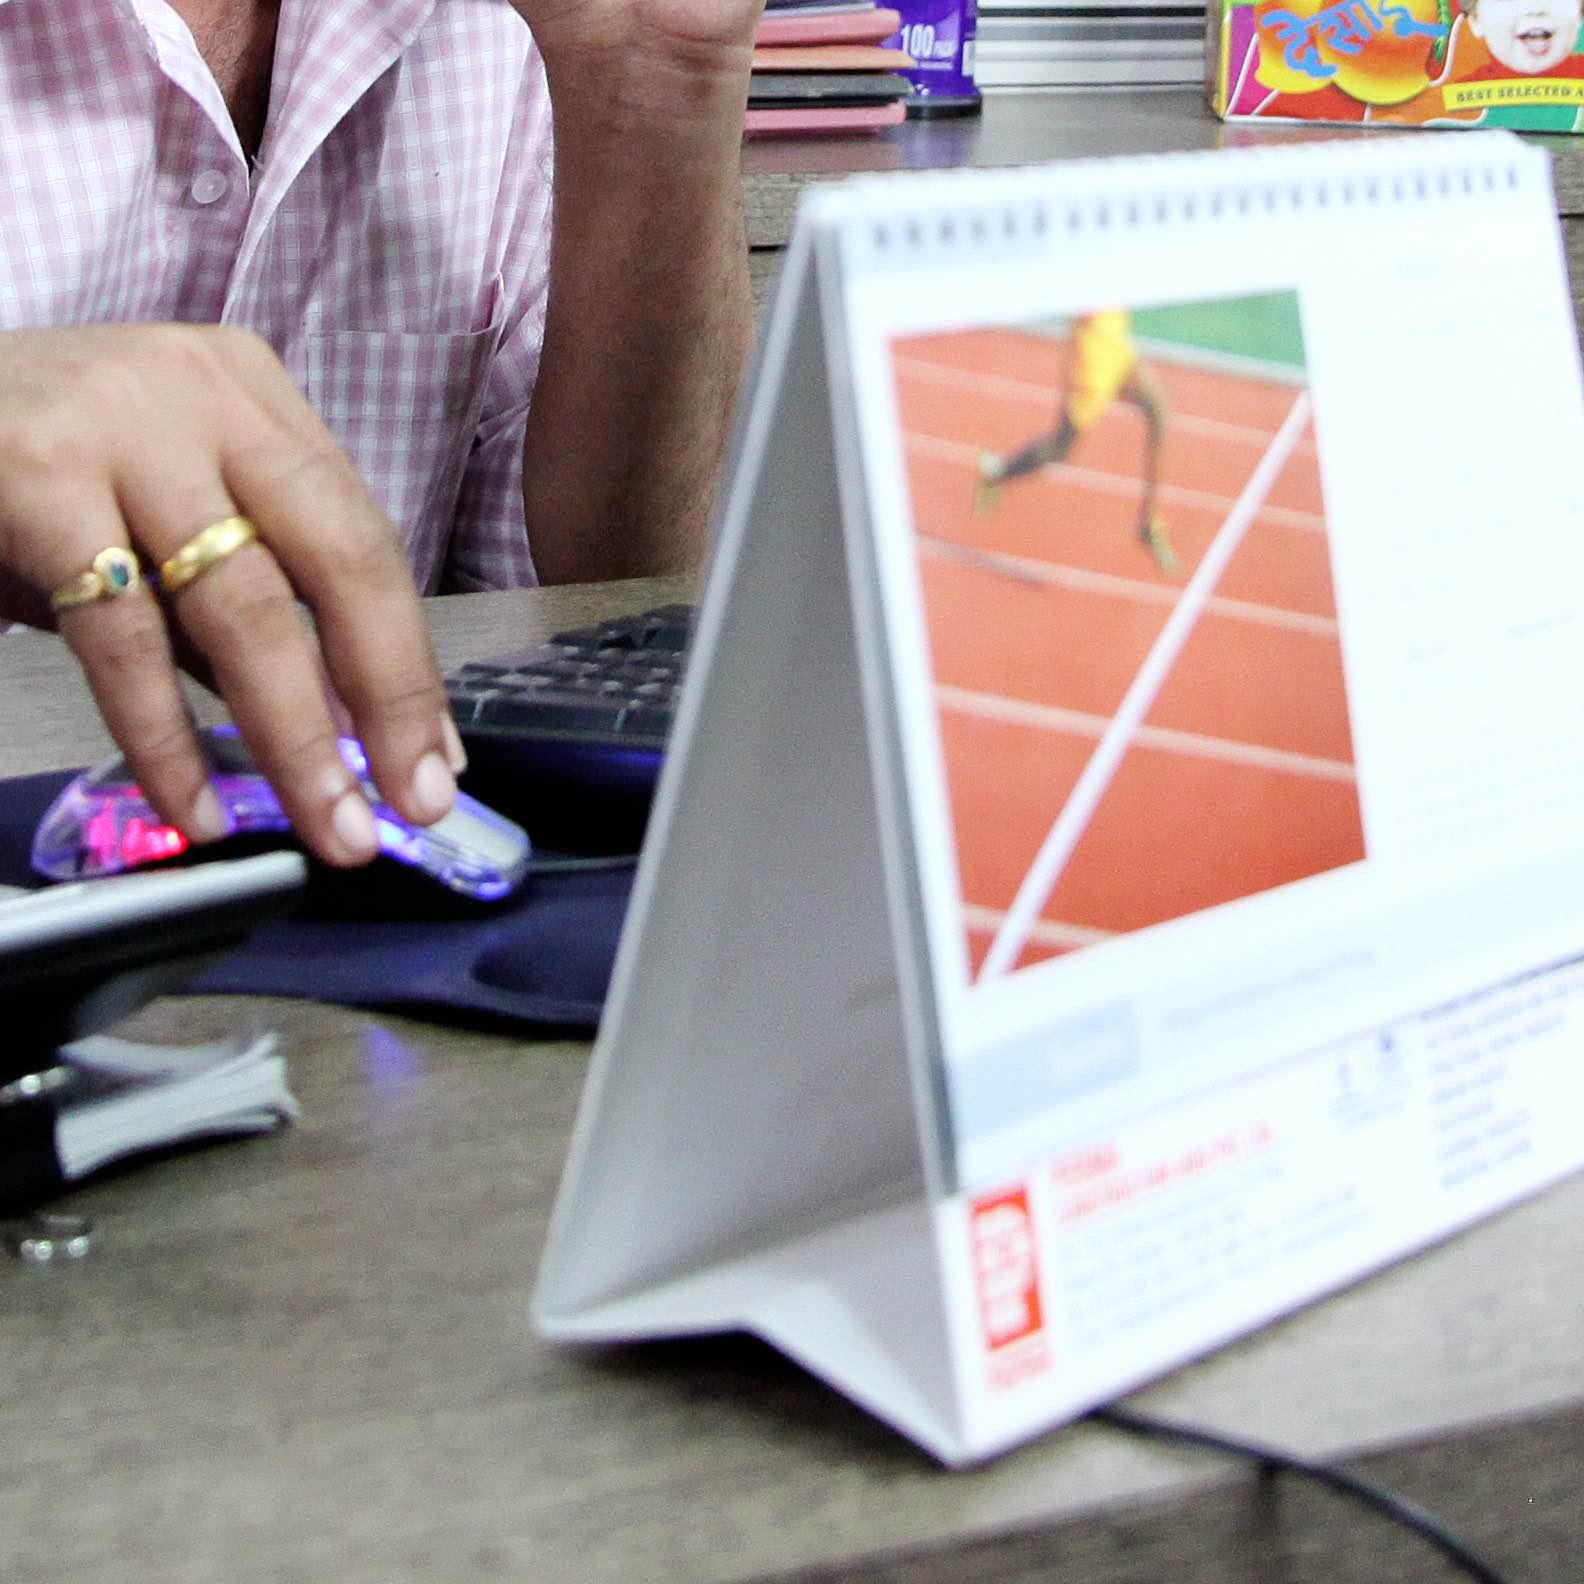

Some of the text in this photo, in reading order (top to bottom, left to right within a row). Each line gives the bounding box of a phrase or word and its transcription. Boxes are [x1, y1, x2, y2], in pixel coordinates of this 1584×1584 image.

[901, 24, 935, 59] 100
[1456, 87, 1493, 103] BEST
[1498, 85, 1571, 99] SELECTED
